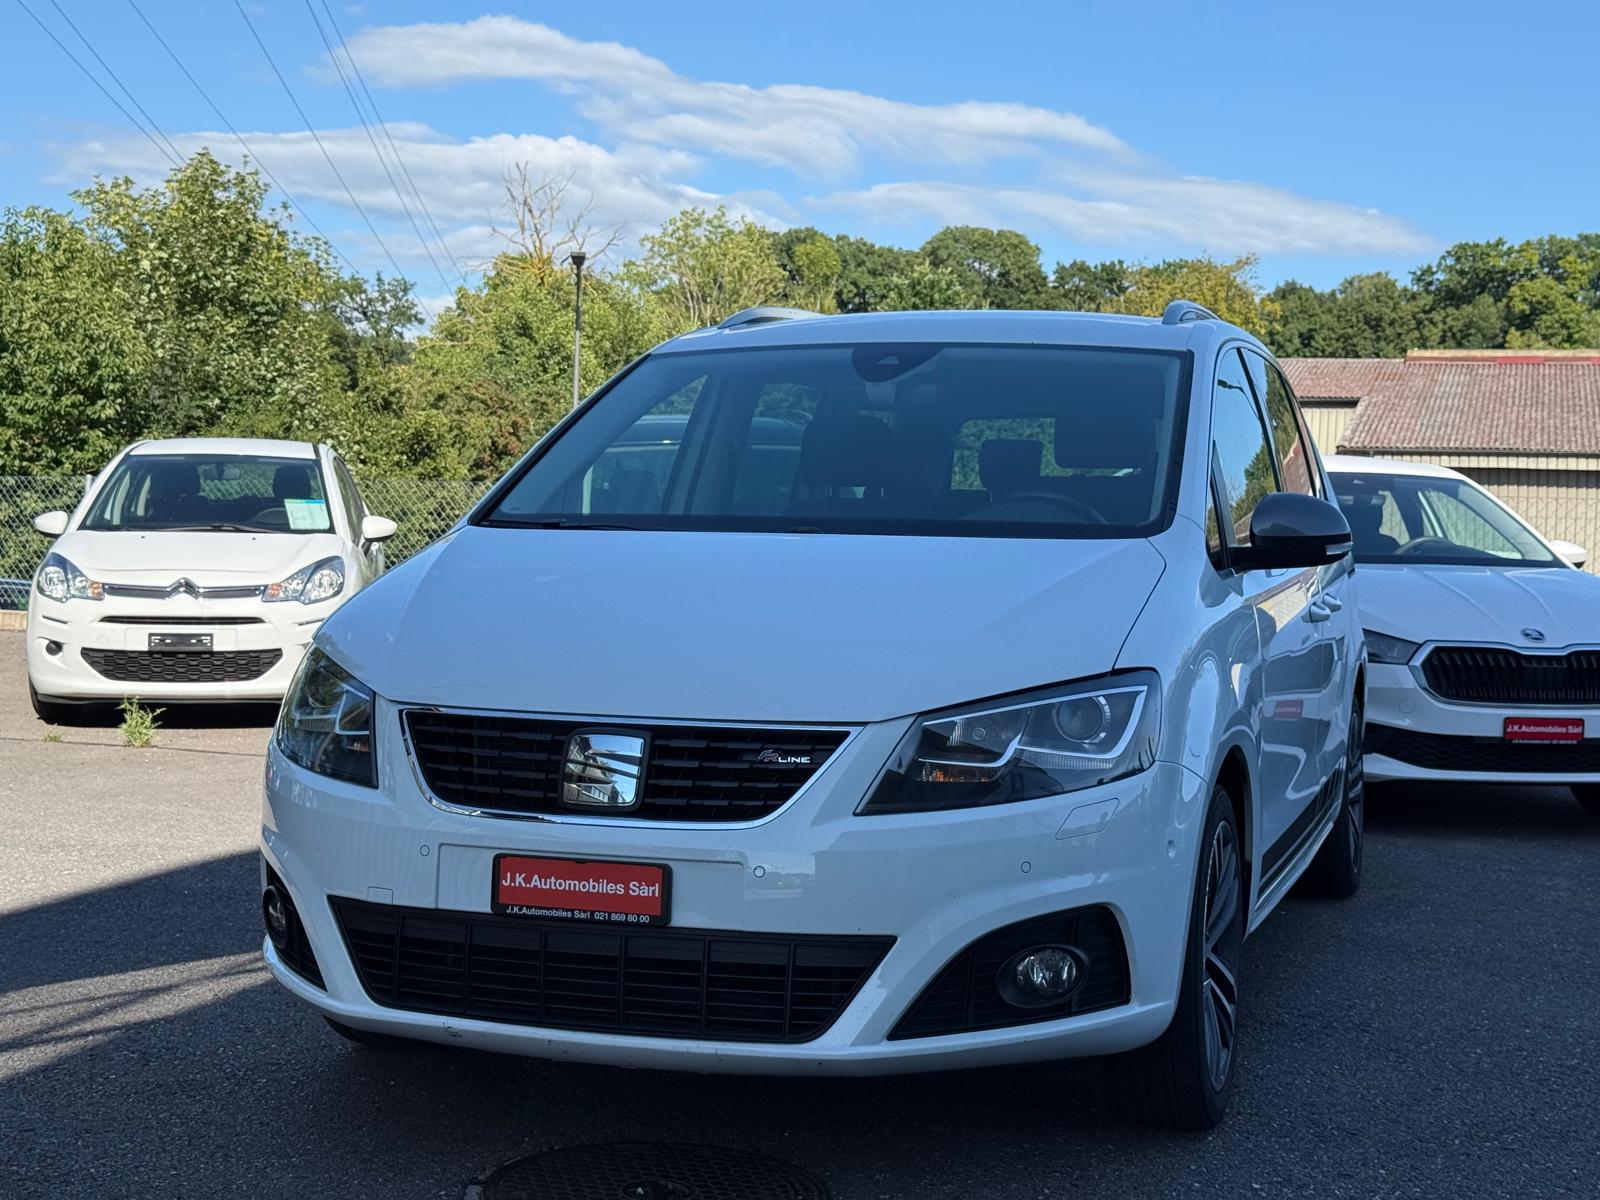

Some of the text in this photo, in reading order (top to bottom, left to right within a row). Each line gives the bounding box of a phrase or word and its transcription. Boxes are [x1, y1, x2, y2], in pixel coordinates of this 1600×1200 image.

[502, 872, 660, 897] J.K.Automobiles Sàrl
[506, 906, 572, 918] J.K.Automobiles
[594, 912, 609, 921] 021
[611, 913, 626, 922] 869
[627, 914, 638, 923] 80
[639, 915, 650, 923] 00
